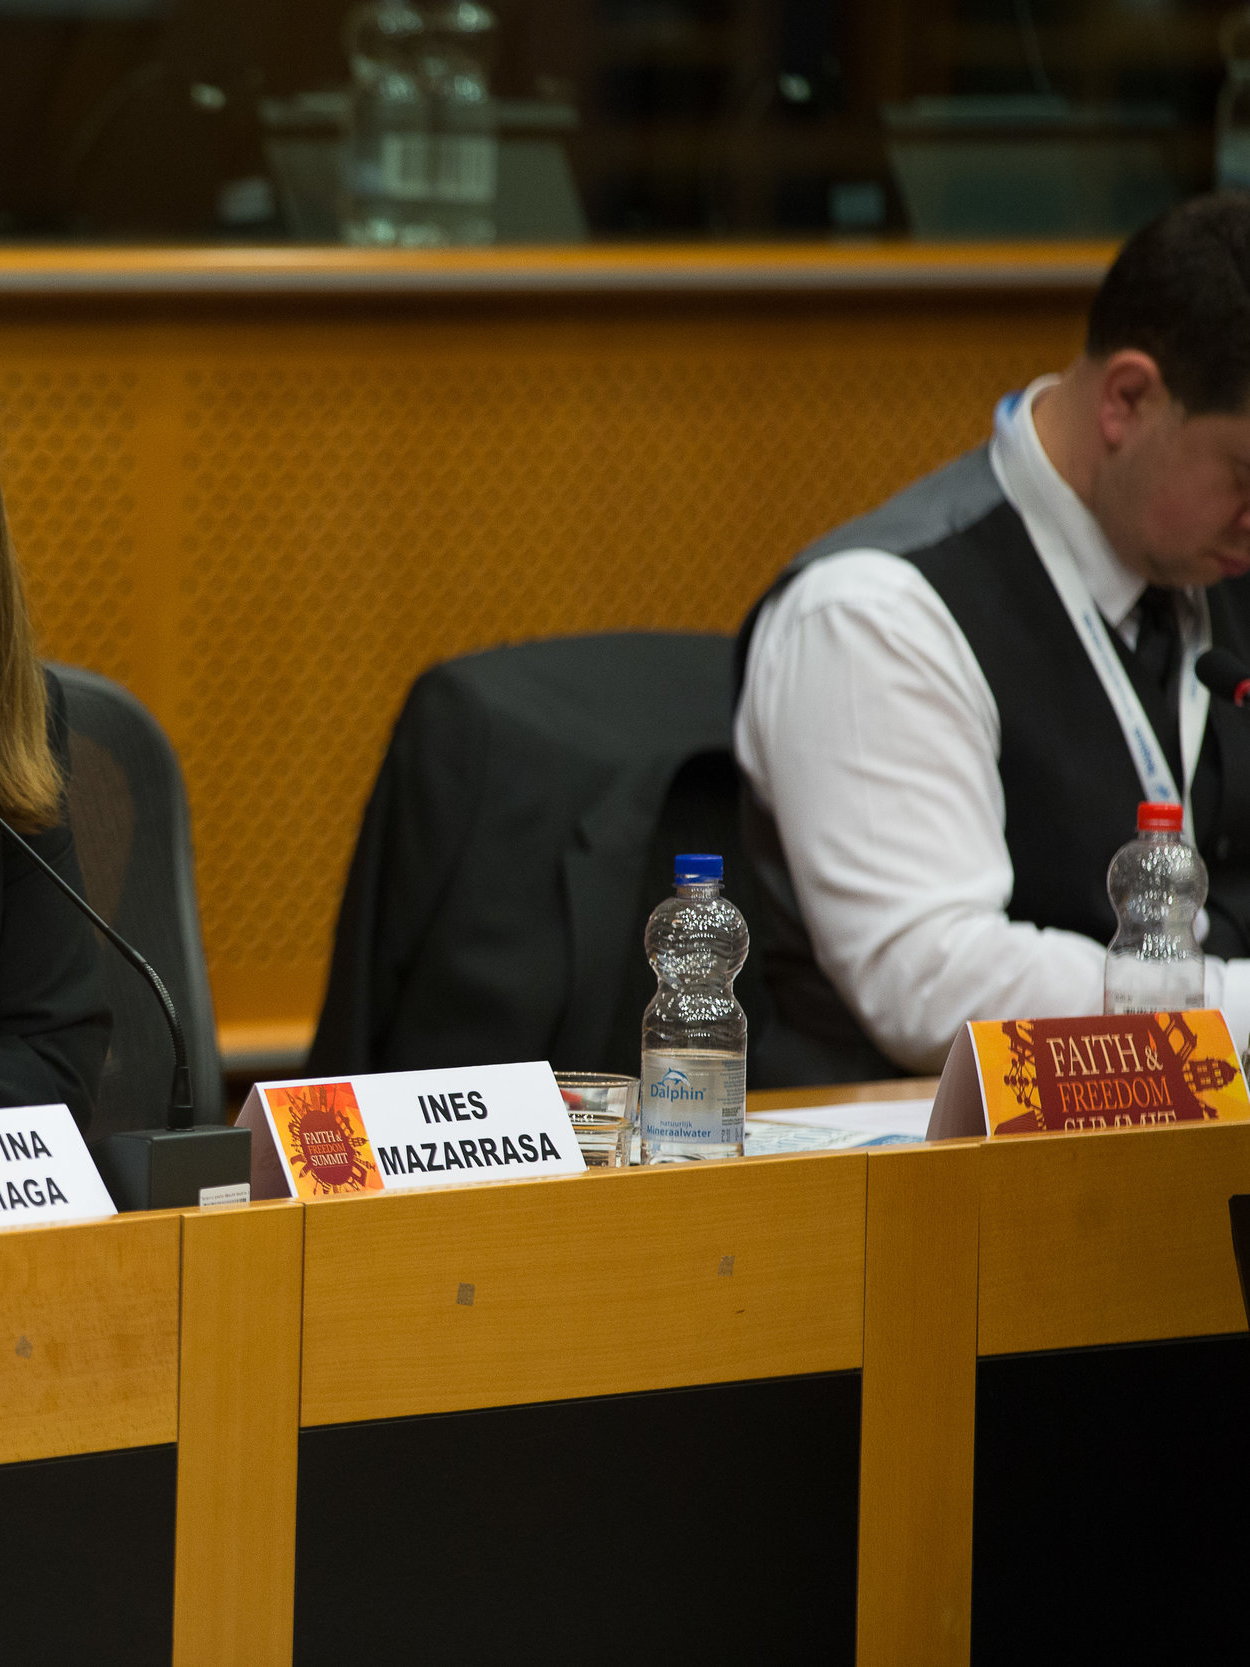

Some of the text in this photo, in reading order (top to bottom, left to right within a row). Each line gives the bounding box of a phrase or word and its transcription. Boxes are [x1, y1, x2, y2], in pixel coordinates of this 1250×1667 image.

[1046, 1032, 1164, 1078] FAITH &
[650, 1083, 705, 1102] Dalphin
[1057, 1075, 1174, 1114] FREEDOM
[417, 1090, 488, 1124] INES
[303, 1130, 336, 1145] FAITH
[646, 1125, 711, 1138] Mineraalwater
[307, 1142, 347, 1155] FREEDOM
[377, 1131, 562, 1176] MAZARRASA
[310, 1152, 349, 1167] SUMMIT
